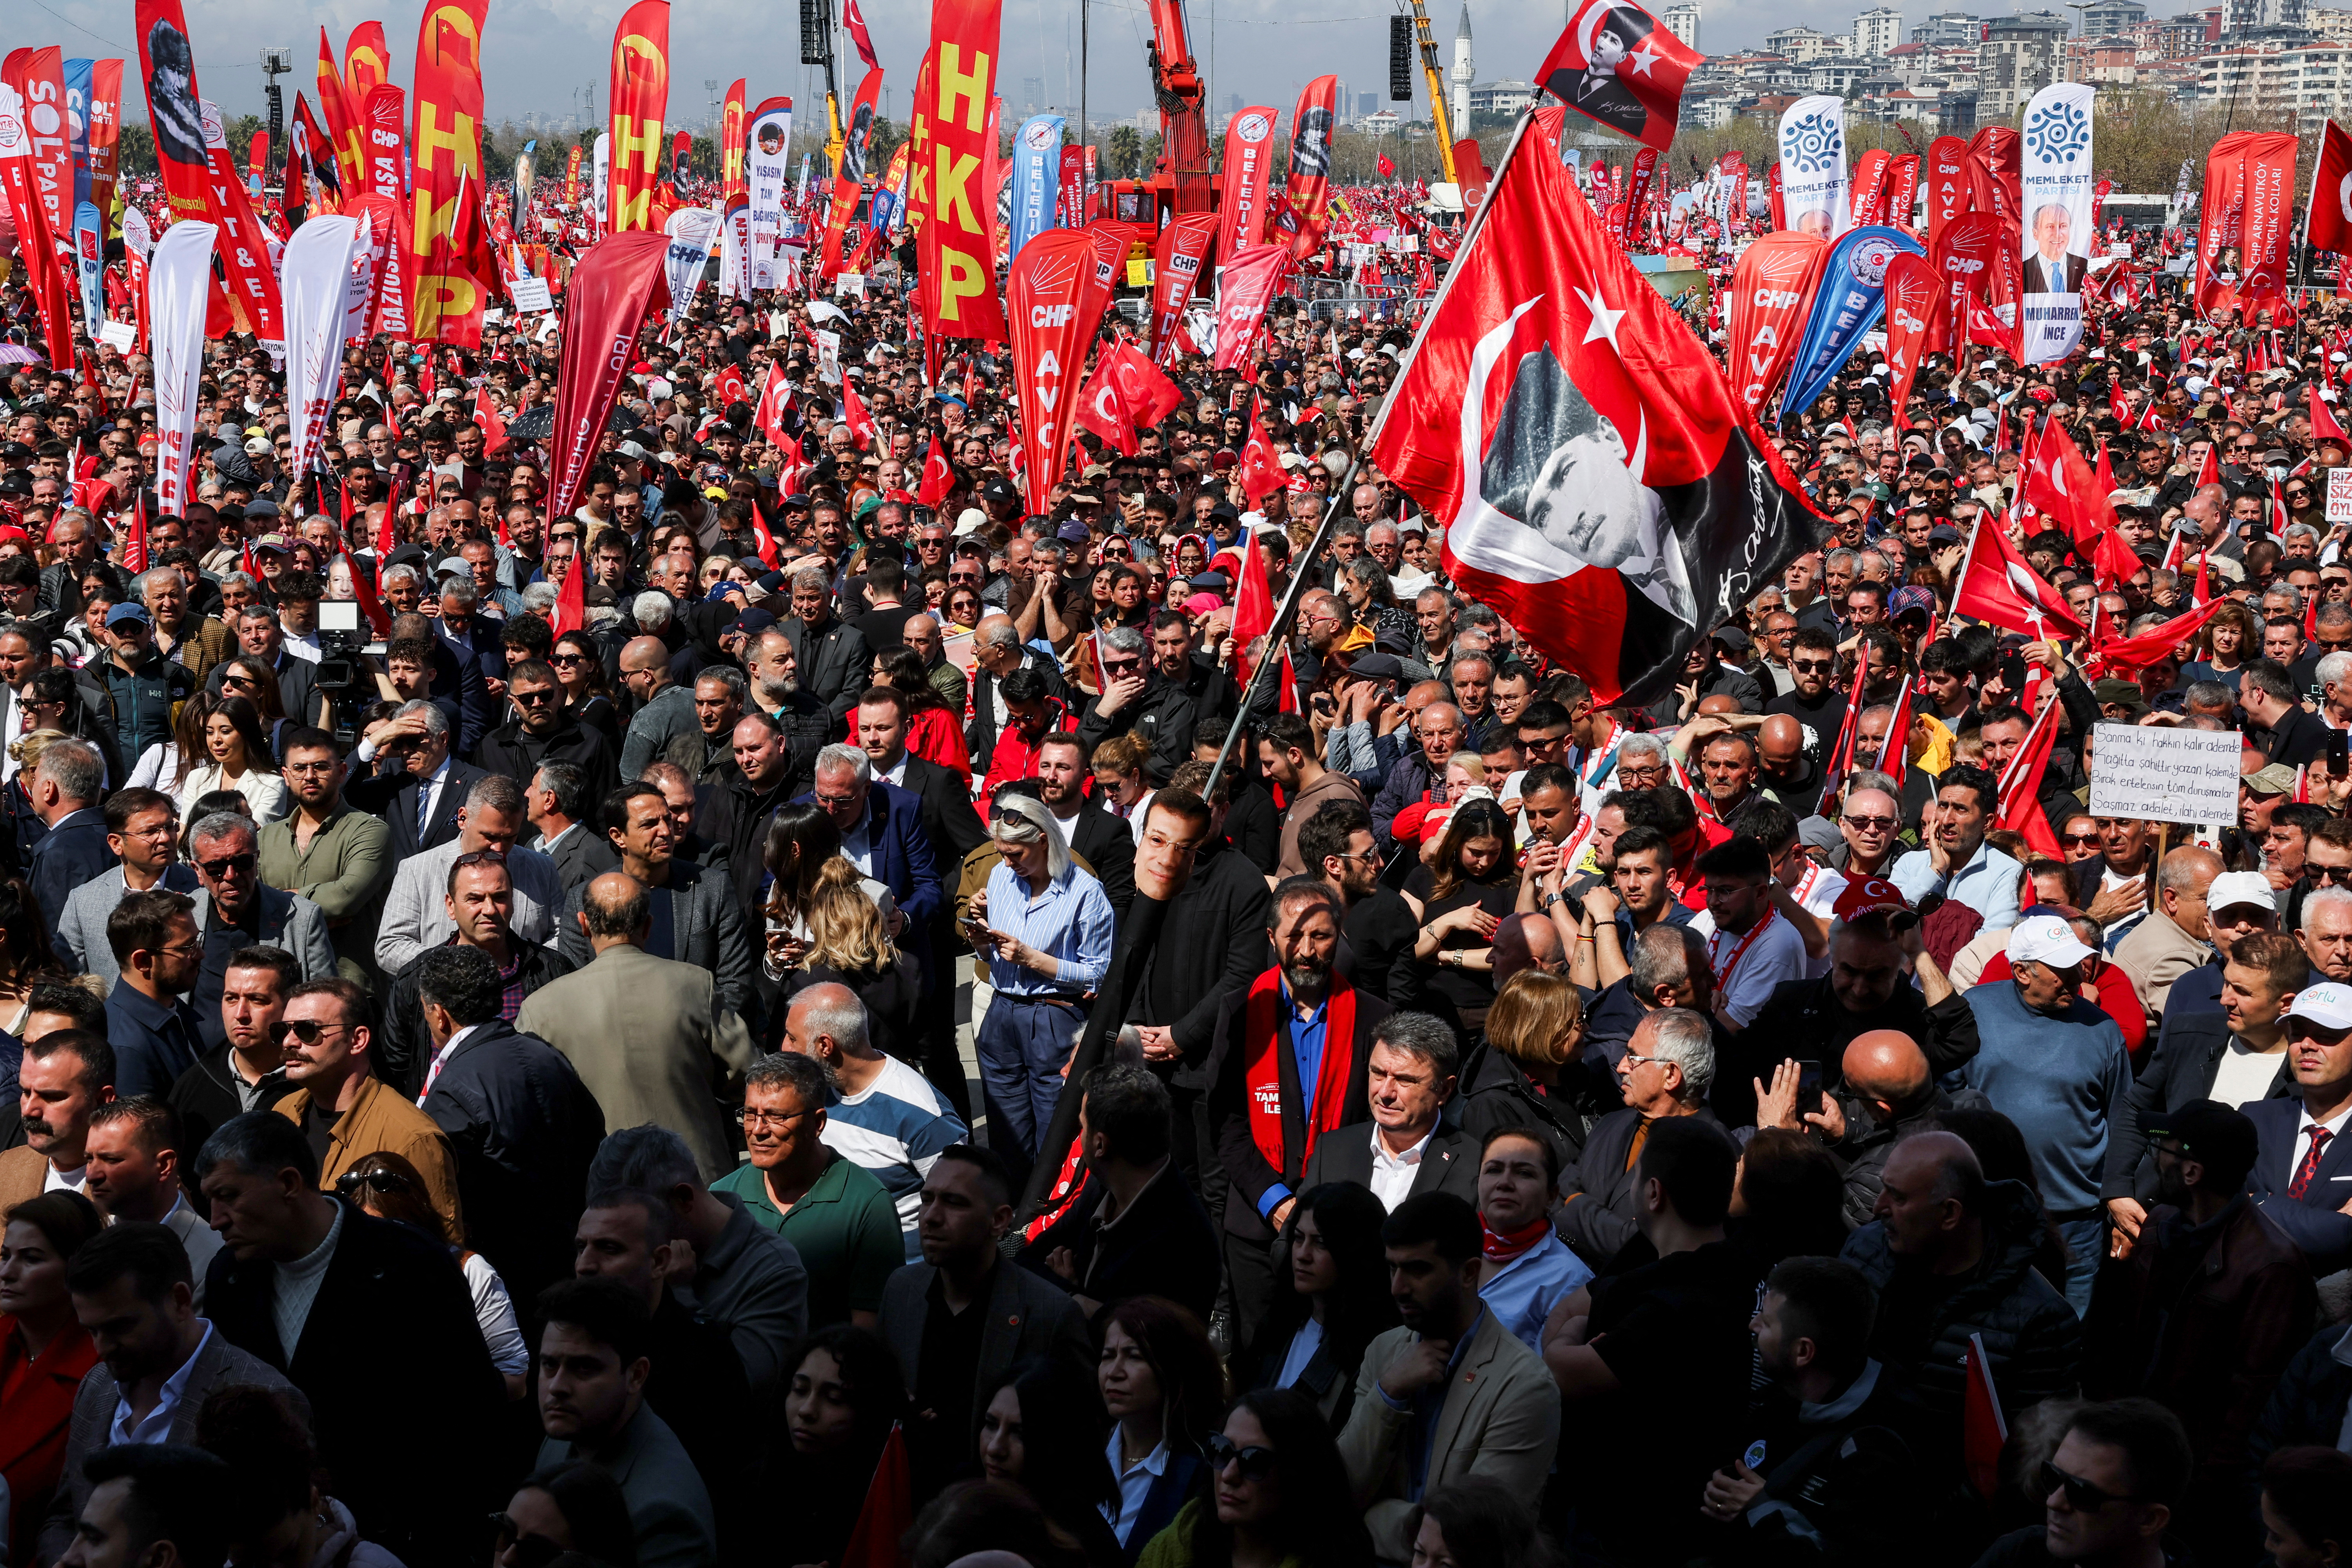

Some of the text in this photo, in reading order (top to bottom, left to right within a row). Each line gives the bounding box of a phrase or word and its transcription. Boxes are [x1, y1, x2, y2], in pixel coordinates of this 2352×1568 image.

[28, 78, 63, 157] SOL
[91, 100, 112, 117] OL
[372, 128, 399, 148] CHP
[89, 144, 109, 156] imdi
[90, 158, 104, 168] OL
[756, 165, 781, 181] YAŞASIN
[887, 145, 909, 192] tmmo
[1636, 169, 1650, 178] CHP
[1938, 164, 1960, 174] CHP
[567, 162, 577, 203] EMEK
[936, 41, 989, 321] HKP
[1787, 179, 1845, 195] MEMLEKET
[1865, 159, 1885, 209] KOLLARI
[1900, 162, 1915, 210] KOLLARI
[2026, 174, 2089, 185] MEMLEKET
[36, 163, 60, 234] PART
[168, 191, 207, 212] Bağımsızlık
[760, 188, 772, 200] TAM
[1027, 156, 1044, 240] BELEDİ
[1292, 192, 1317, 201] Bağımsızlık
[1941, 182, 1956, 220] AVC
[753, 207, 778, 223] BAĞIMSIZ
[1068, 185, 1077, 228] ATAŞEHİR
[1301, 211, 1323, 221] kterimdir!
[1626, 180, 1644, 237] MALTEPE
[1851, 193, 1867, 229] LTEPE
[1889, 195, 1900, 229] LTEPE
[1989, 127, 2014, 300] AVCILAR KOLLARI
[2251, 162, 2267, 264] CHP ARNAVUTKÖY
[2266, 168, 2282, 264] GENÇLİK KOLLARI
[2221, 205, 2231, 247] NAVUTKÖY
[2228, 215, 2241, 248] ADIN
[371, 245, 385, 262] HP
[668, 243, 706, 264] CHP
[2208, 229, 2220, 257] CHP
[1097, 263, 1110, 277] HP
[1173, 255, 1198, 271] CHP
[1946, 256, 1984, 274] CHP
[1753, 289, 1800, 309] CHP
[1031, 305, 1076, 328] CHP
[1230, 304, 1264, 321] CHP
[2043, 325, 2065, 341] İNCE
[1744, 326, 1777, 405] AVC
[1035, 350, 1062, 510] AVCI
[2330, 499, 2352, 515] ÖYL
[2095, 724, 2240, 753] Sanma ki hakkın kalır ademde
[2094, 746, 2238, 780] Kağıtta şahittir yazan kalem'de
[2092, 769, 2234, 799] Bırak ertelensin tüm duruşmalar
[2092, 790, 2233, 821] Şaşmaz adalet, ilahi alemde
[1254, 1092, 1279, 1102] TAM
[1264, 1101, 1281, 1114] İLE
